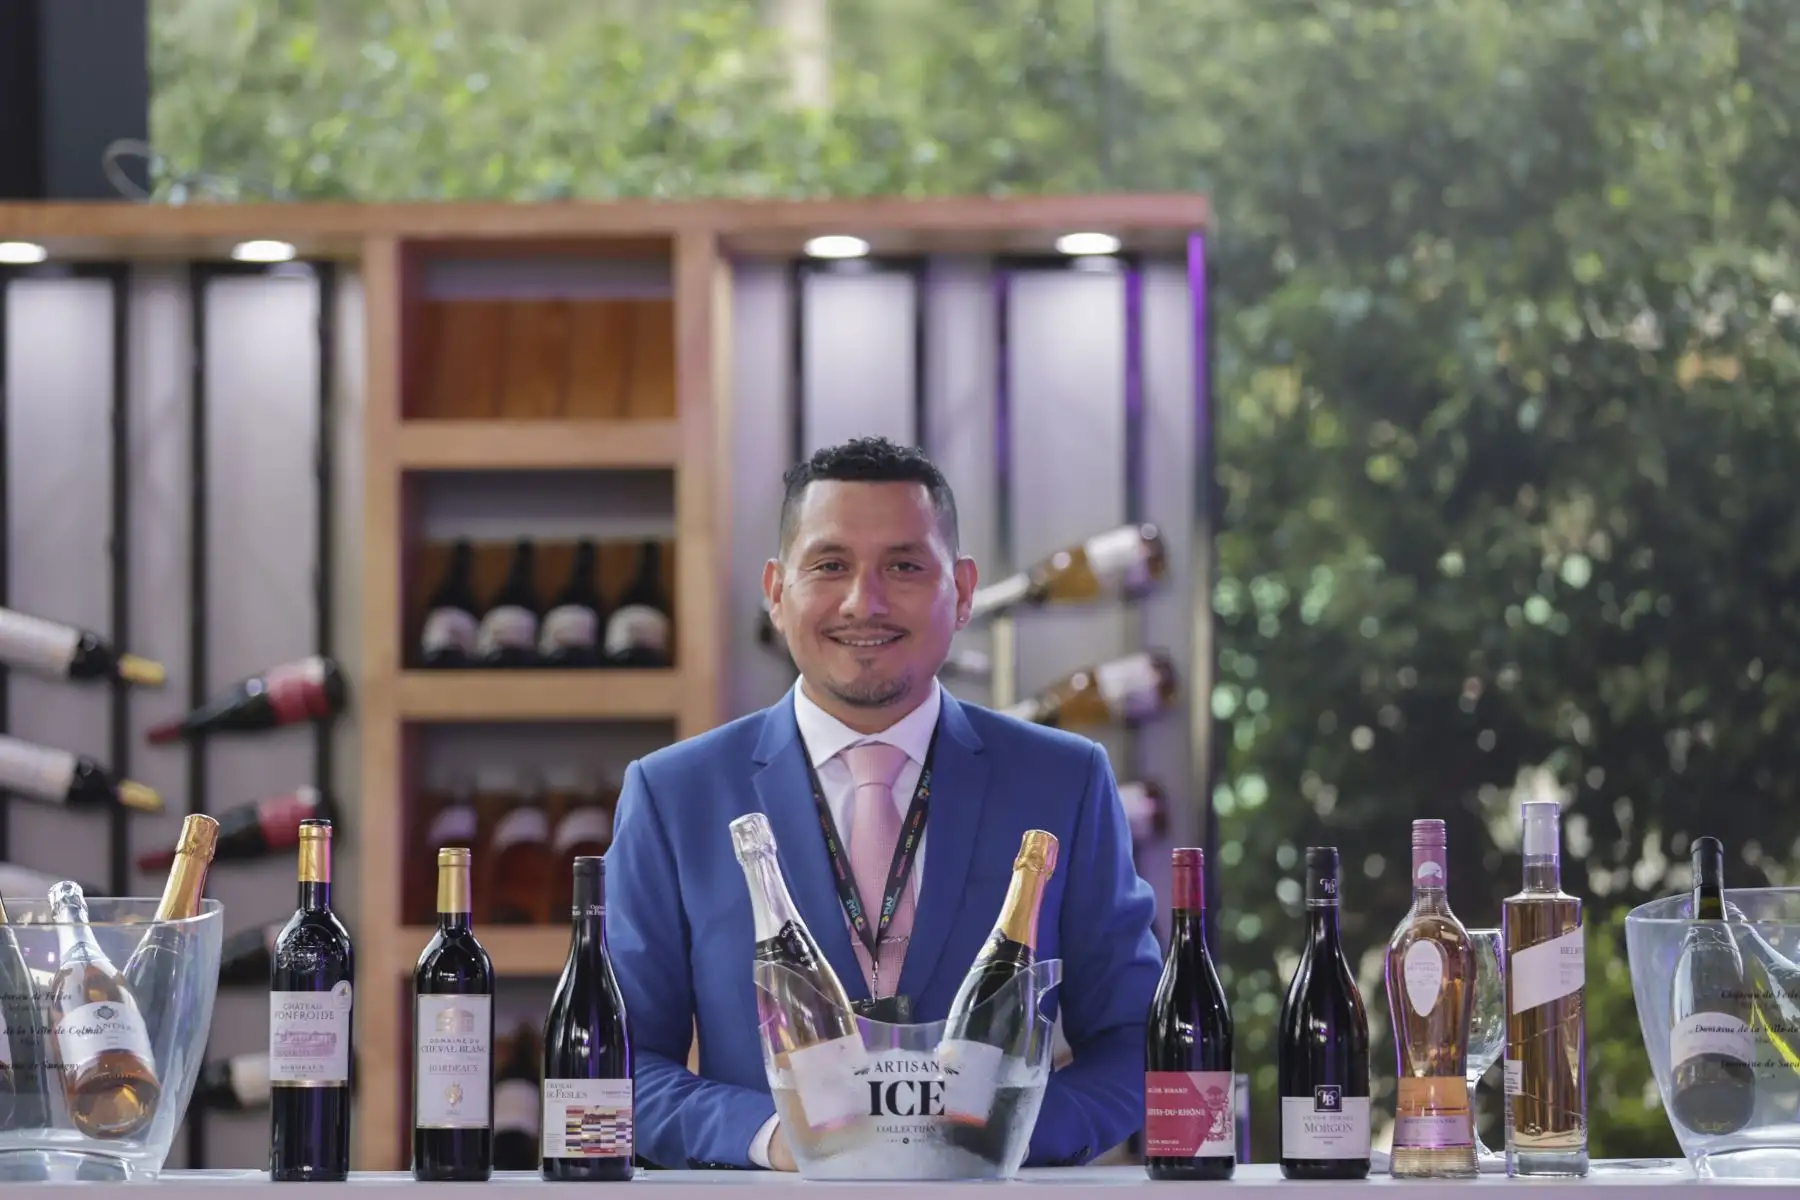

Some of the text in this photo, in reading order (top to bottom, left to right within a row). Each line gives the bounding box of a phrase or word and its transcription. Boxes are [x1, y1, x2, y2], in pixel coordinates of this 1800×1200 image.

[1695, 1024, 1735, 1033] Domaine
[1737, 1024, 1748, 1033] de
[421, 1045, 487, 1053] CHEVAL BLANC
[875, 1061, 940, 1073] ARTISAN
[867, 1079, 946, 1117] ICE
[877, 1125, 936, 1133] COLLECTION
[1304, 1122, 1353, 1133] MORGON
